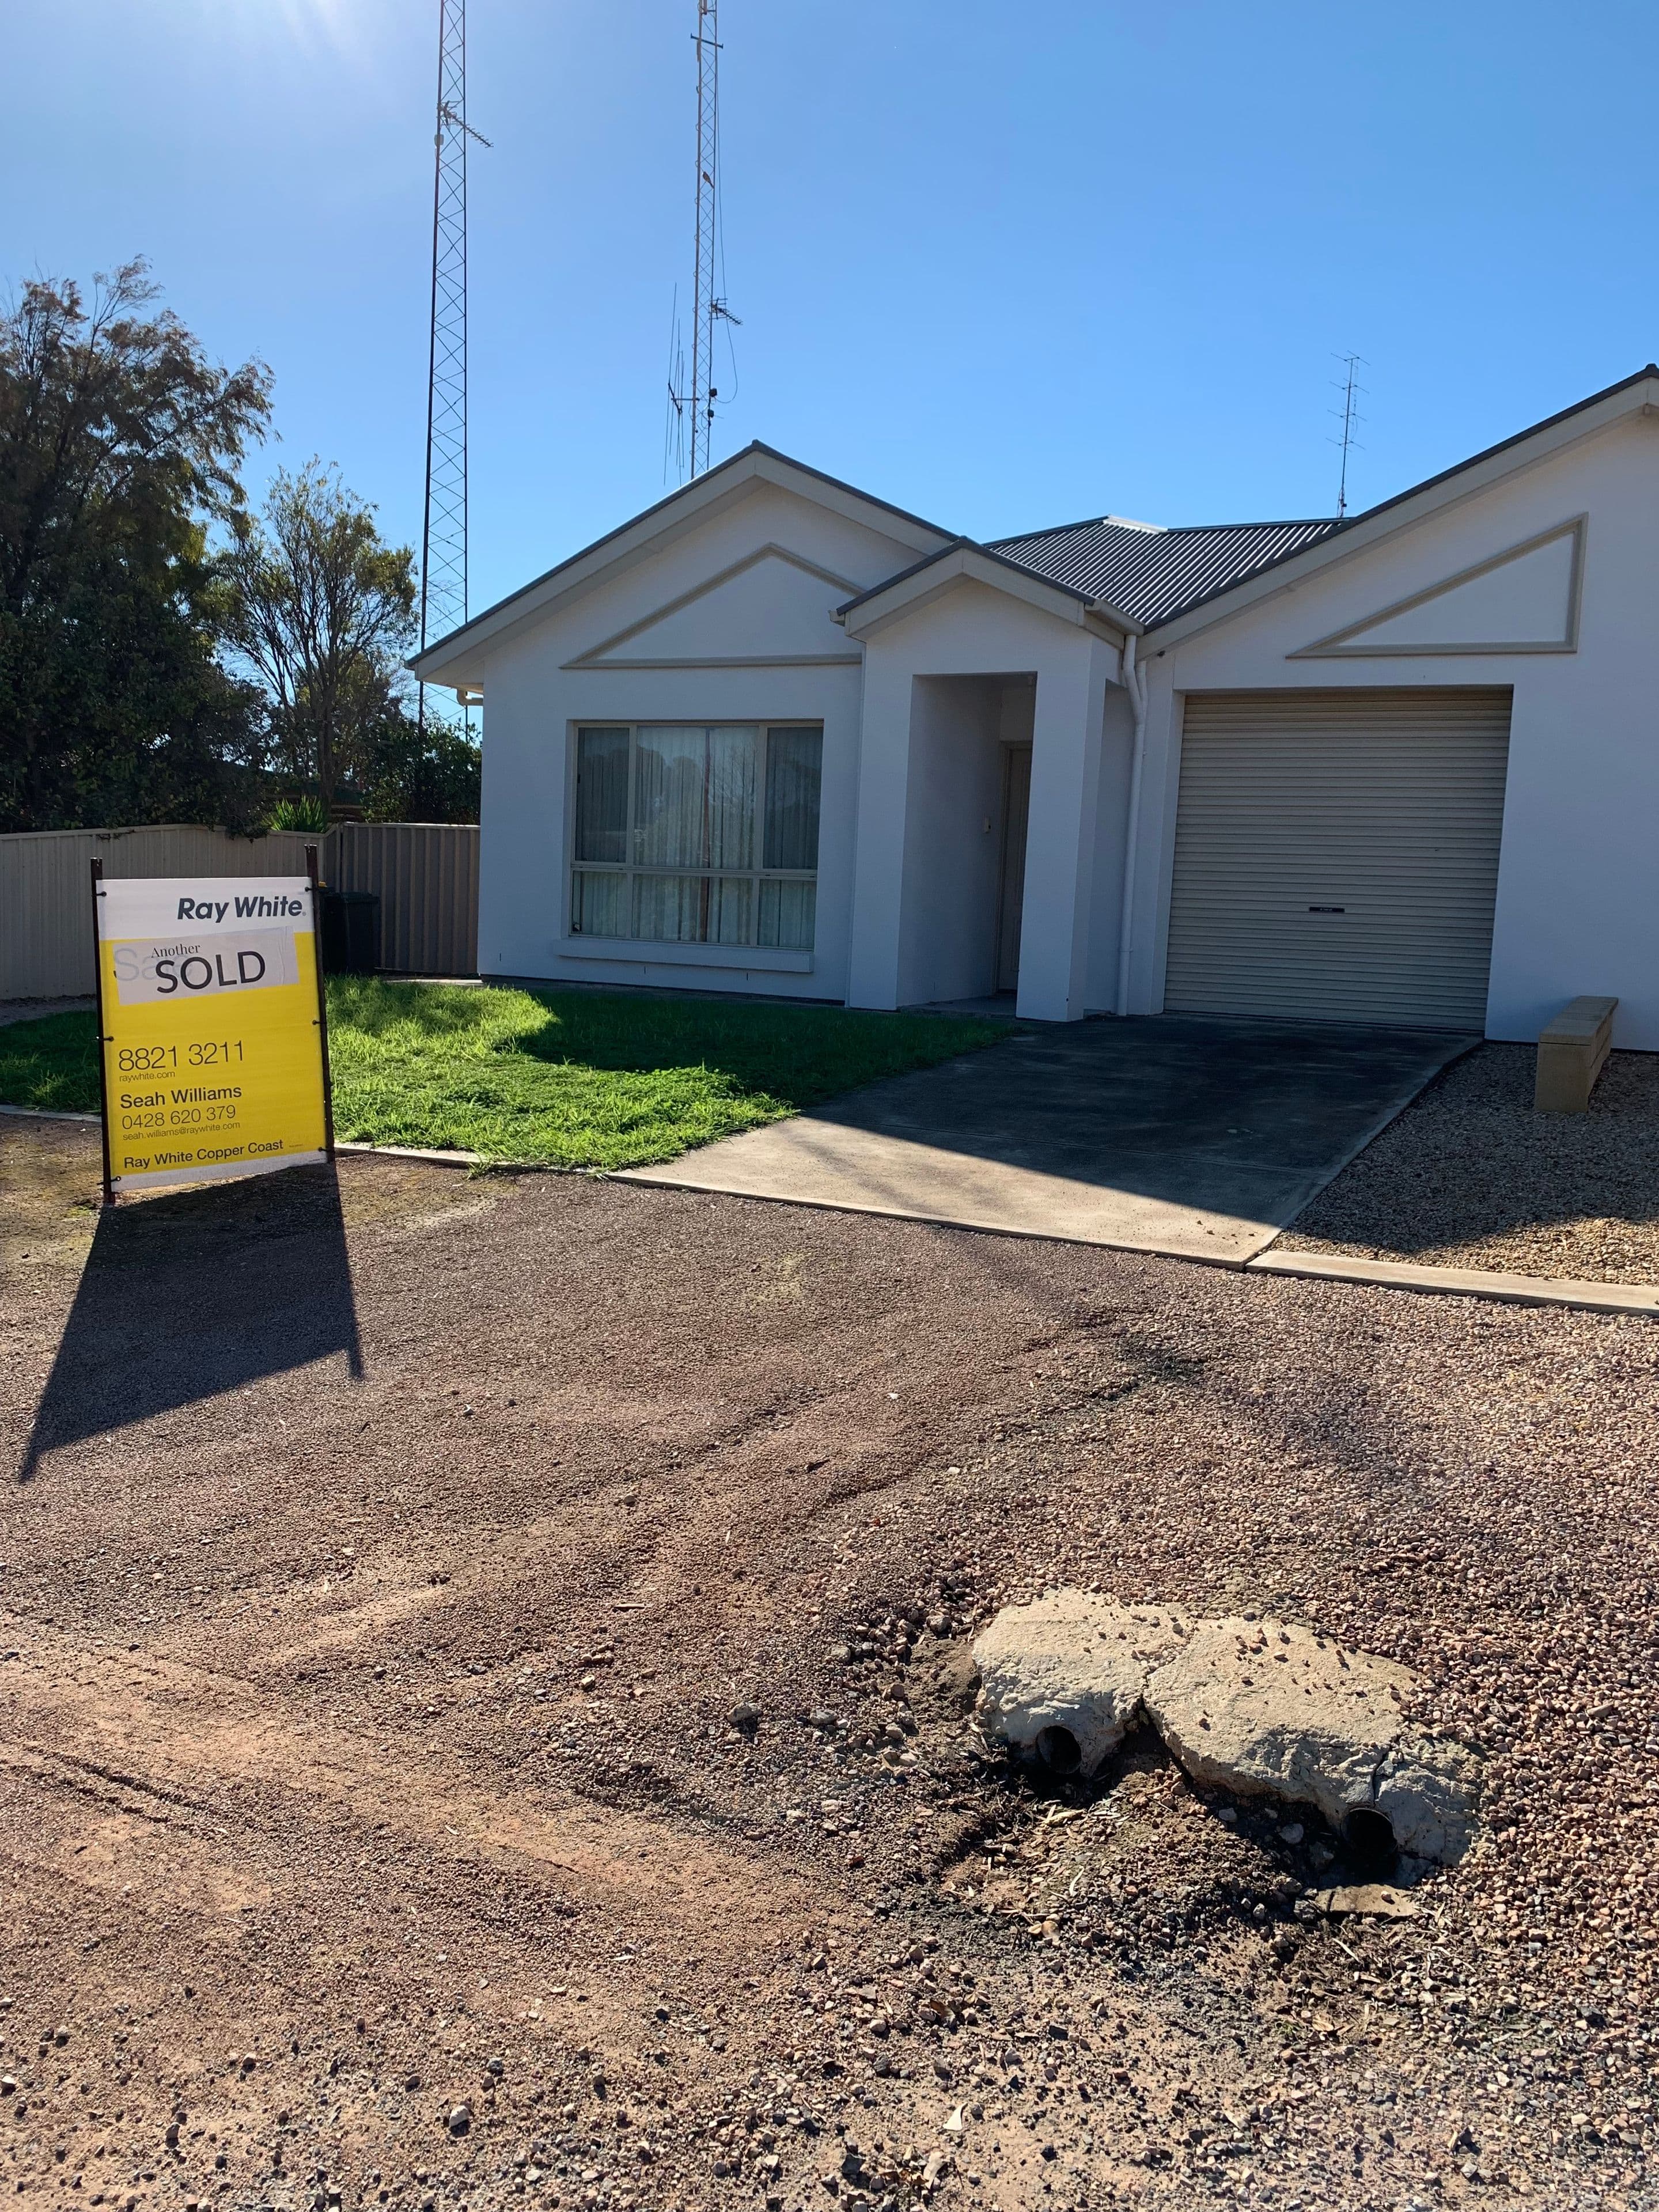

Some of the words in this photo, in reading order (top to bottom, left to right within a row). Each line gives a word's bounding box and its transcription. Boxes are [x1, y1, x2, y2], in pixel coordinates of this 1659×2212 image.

[177, 897, 229, 923] Ray
[234, 896, 302, 918] White
[151, 944, 201, 959] Another
[156, 950, 266, 993] SOLD
[119, 1046, 177, 1071] 8821
[188, 1040, 243, 1066] 3211
[119, 1071, 175, 1083] raywhite.com
[120, 1092, 165, 1109] Seah
[171, 1086, 242, 1104] Williams
[122, 1112, 165, 1129] 0428
[171, 1108, 201, 1125] 620
[206, 1104, 236, 1121] 379
[123, 1122, 240, 1141] seah.williams@raywhite.com
[124, 1157, 150, 1169] Ray
[154, 1152, 193, 1165] White
[197, 1146, 245, 1161] Copper
[248, 1139, 284, 1153] Coast
